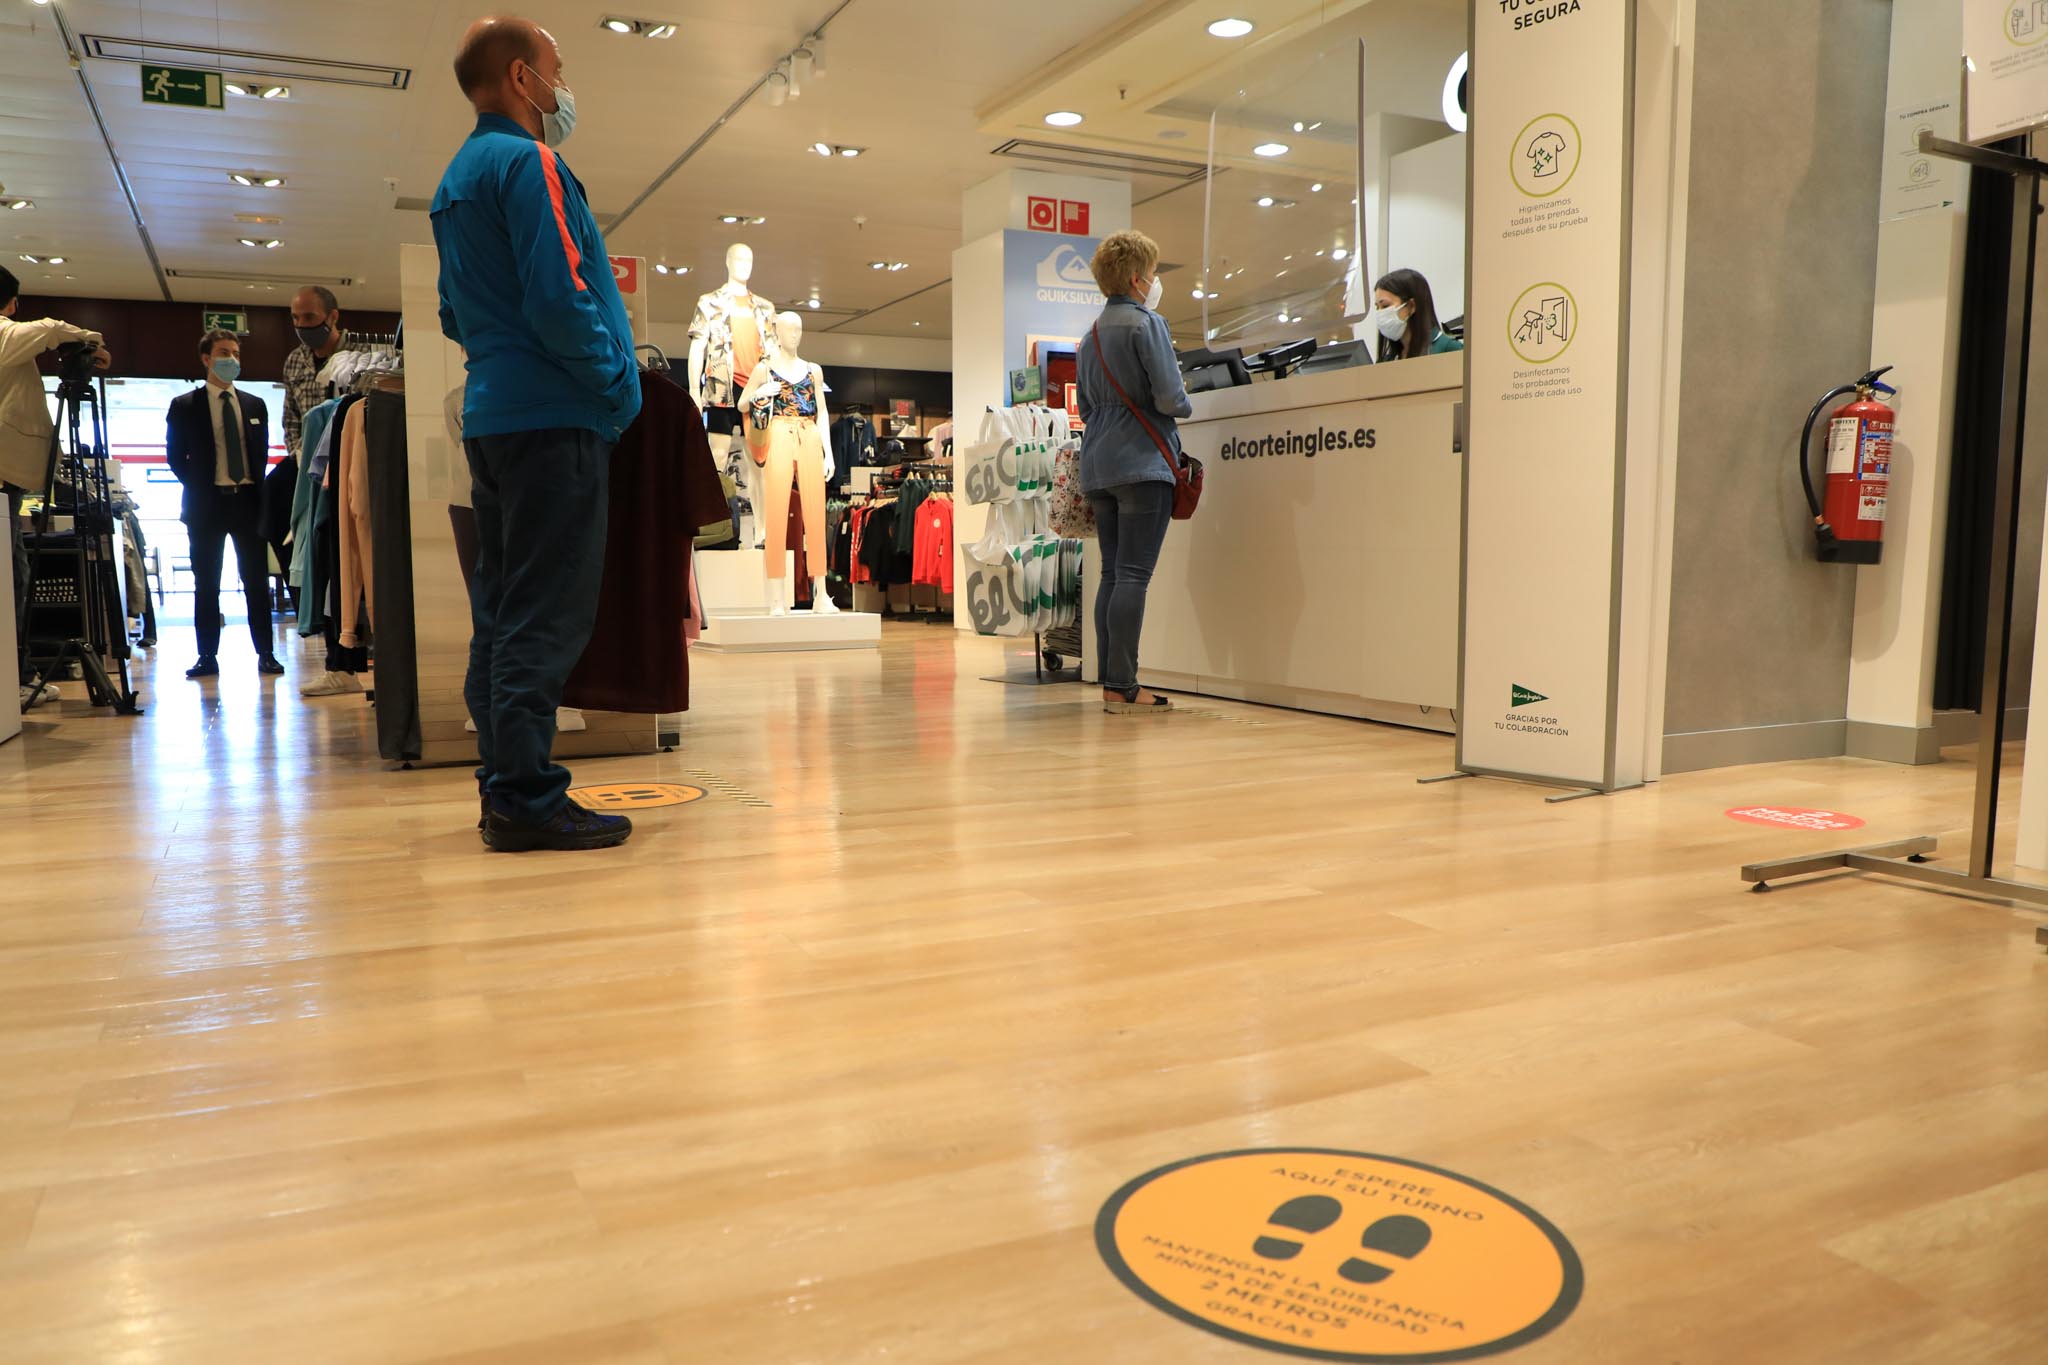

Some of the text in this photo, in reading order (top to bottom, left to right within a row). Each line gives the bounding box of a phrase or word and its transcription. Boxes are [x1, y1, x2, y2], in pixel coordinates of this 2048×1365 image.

[1500, 0, 1519, 14] TU
[1514, 0, 1581, 30] SEGURA
[1511, 216, 1533, 226] todas
[1547, 207, 1580, 220] prendas
[1518, 198, 1571, 213] Higienizamos
[1502, 226, 1534, 239] después
[1536, 223, 1547, 232] de
[1560, 216, 1588, 229] prueba
[1513, 367, 1570, 379] Desinfectamos
[1525, 377, 1570, 389] probadores
[1501, 387, 1582, 401] después de cada uso
[1221, 426, 1376, 461] elcorteingles.es
[1495, 722, 1505, 730] TU
[1505, 713, 1558, 725] GRACIAS POR
[1334, 1167, 1436, 1197] ESPERE
[1343, 1182, 1379, 1198] SU
[1389, 1192, 1485, 1222] TURNO
[1142, 1233, 1466, 1331] MANTENGAN LA DISTANCIA
[1200, 1280, 1350, 1330] 2 METROS
[1243, 1276, 1276, 1291] DE
[1283, 1287, 1429, 1335] SEGURIDAD
[1205, 1300, 1315, 1339] GRACIAS
